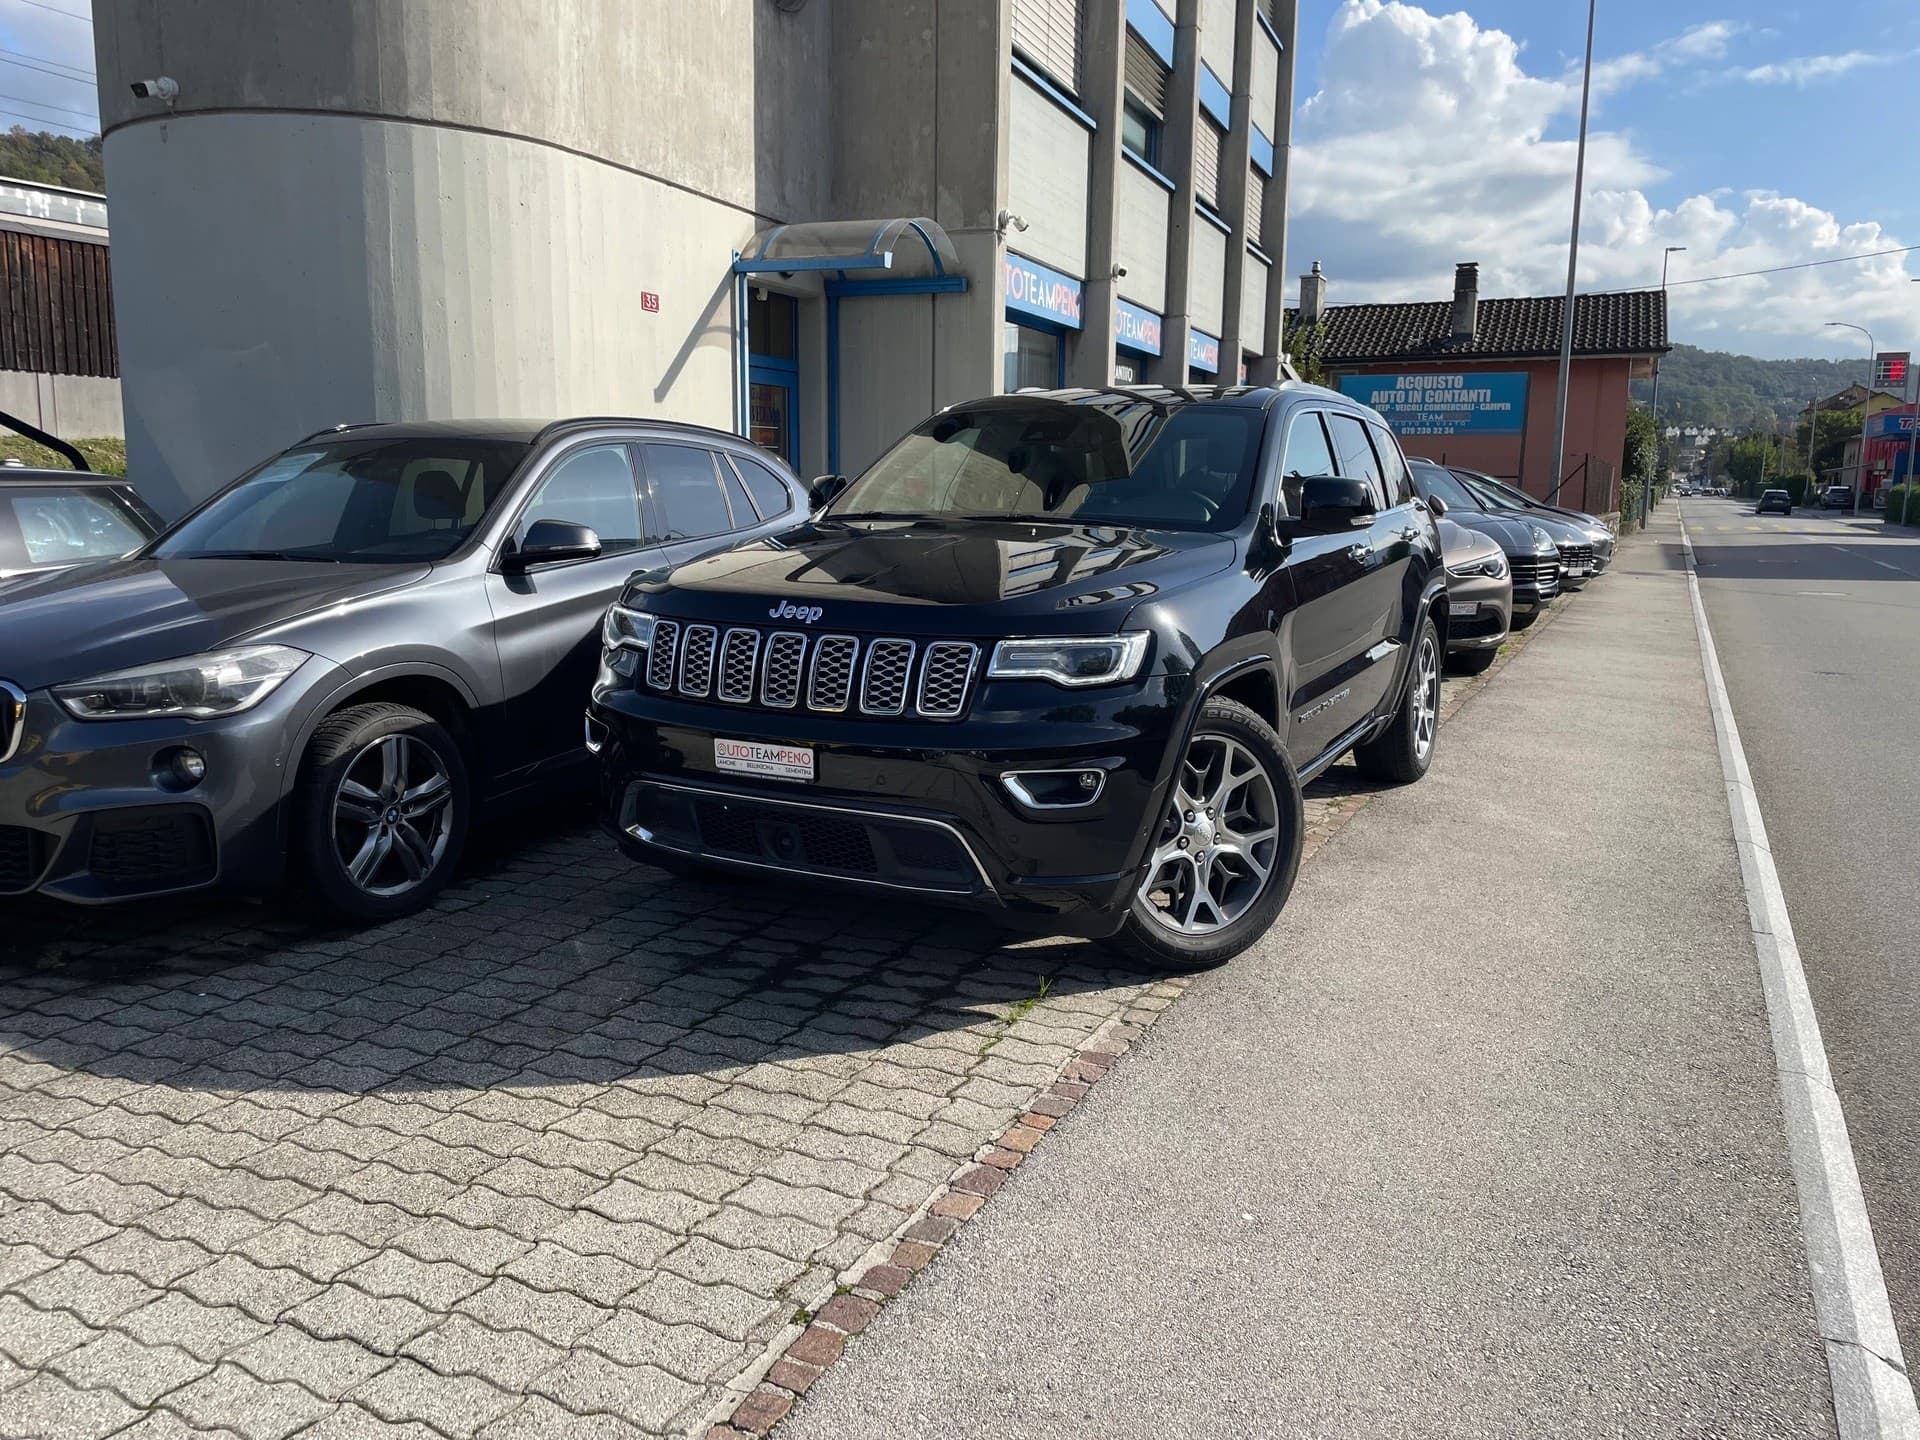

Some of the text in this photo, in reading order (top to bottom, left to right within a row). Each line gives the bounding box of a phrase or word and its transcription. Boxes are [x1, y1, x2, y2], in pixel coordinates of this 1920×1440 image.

[644, 294, 658, 310] 35
[1396, 375, 1464, 390] ACQUISTO
[1371, 389, 1491, 404] AUTO IN CONTANTI
[769, 600, 823, 624] Jeep
